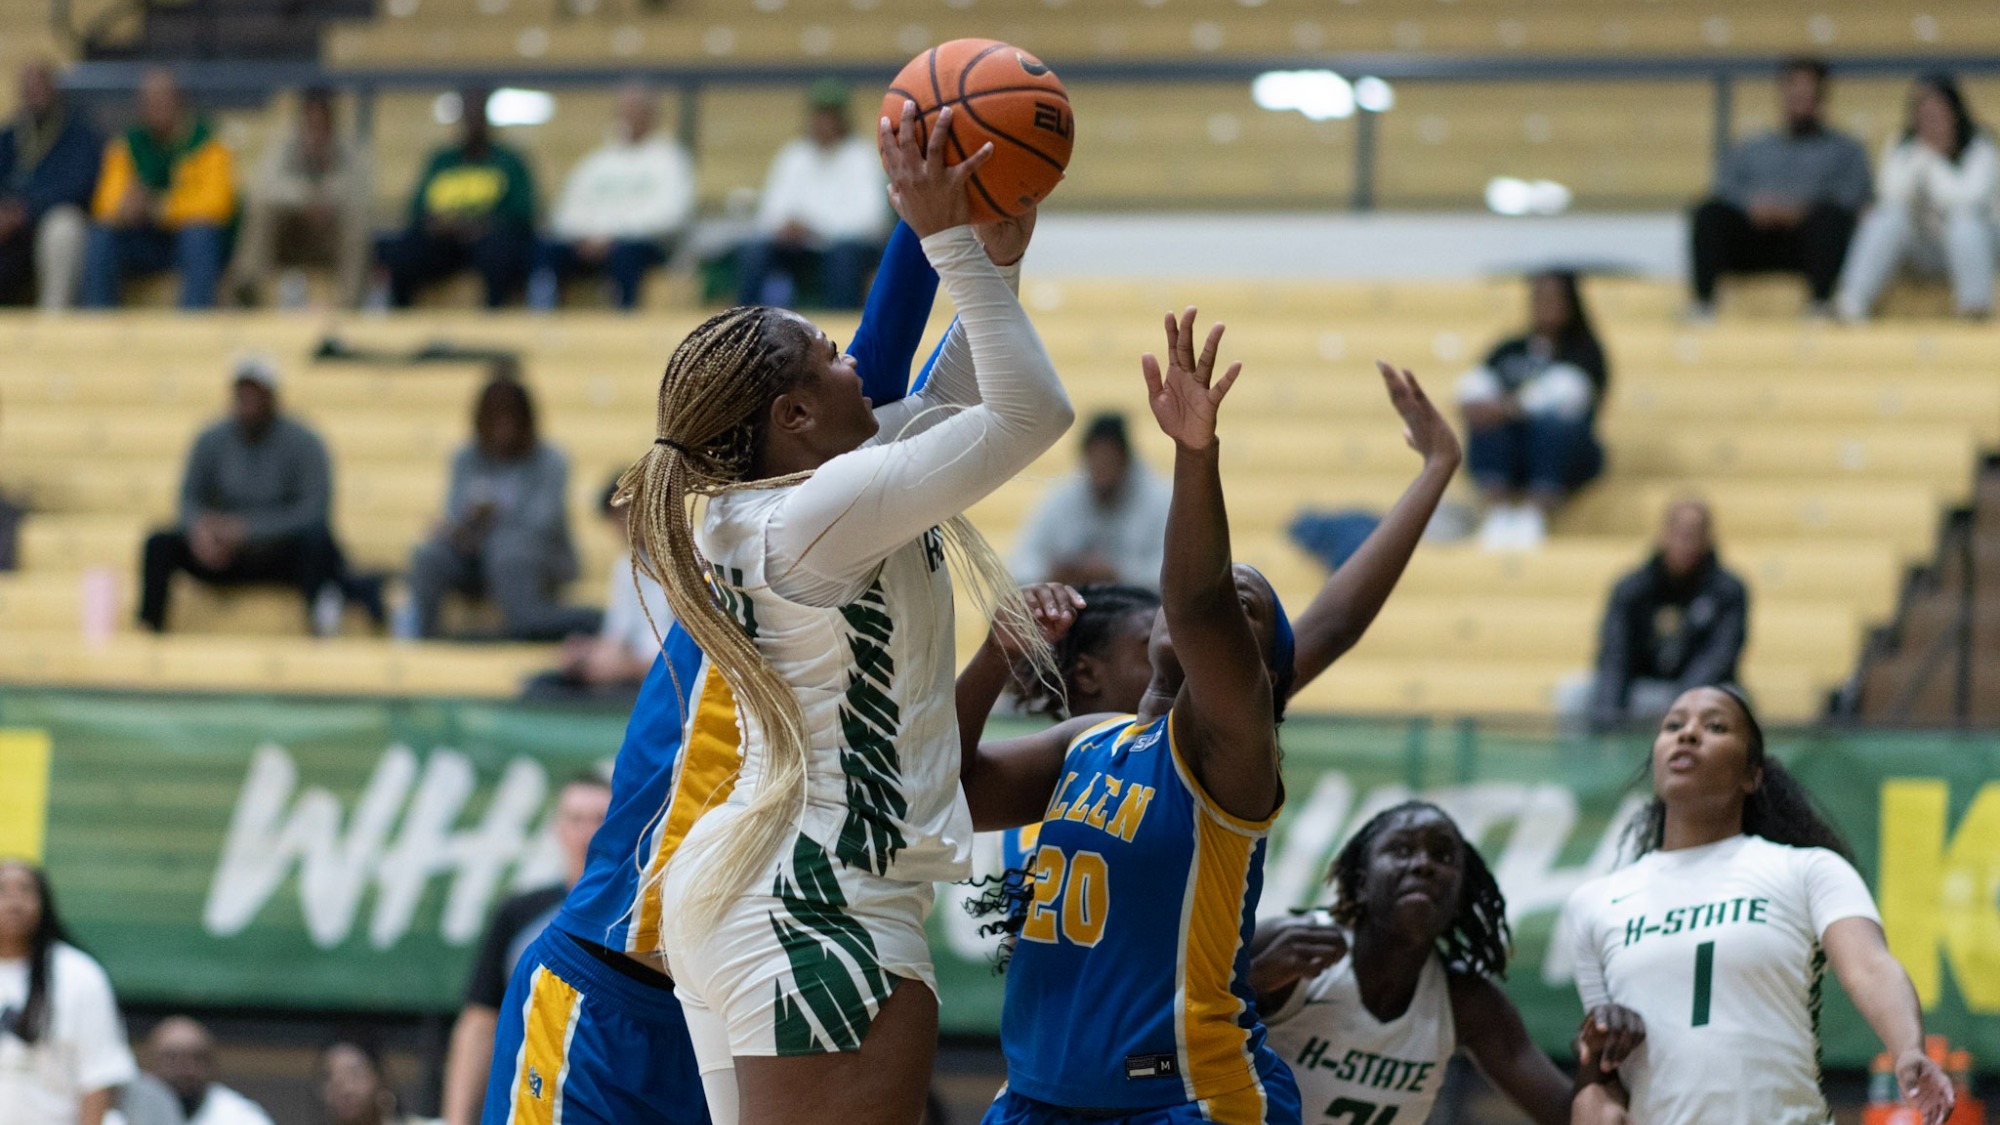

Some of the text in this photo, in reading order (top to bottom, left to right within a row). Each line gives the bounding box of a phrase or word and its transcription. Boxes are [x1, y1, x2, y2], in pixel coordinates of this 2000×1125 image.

[1044, 770, 1156, 843] LLEN
[1020, 844, 1110, 948] 20
[1691, 941, 1715, 1027] 1
[1160, 1060, 1171, 1071] M
